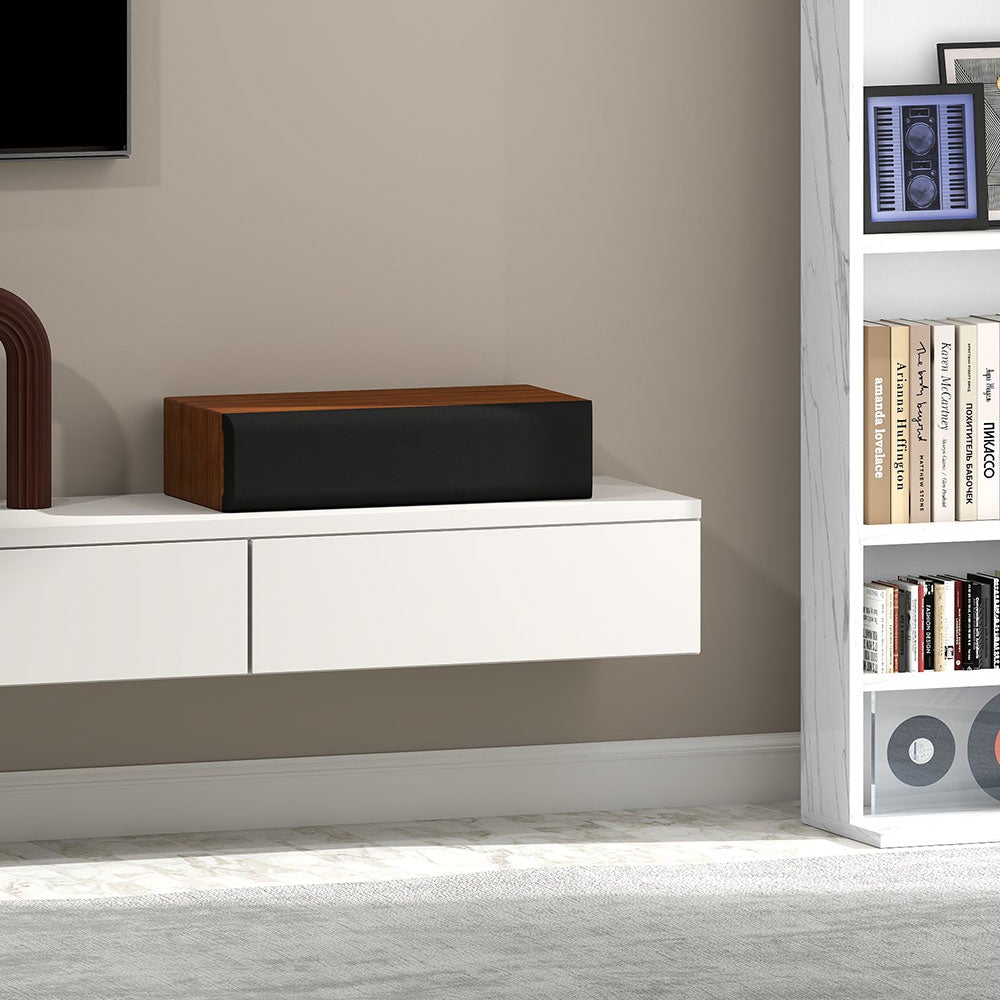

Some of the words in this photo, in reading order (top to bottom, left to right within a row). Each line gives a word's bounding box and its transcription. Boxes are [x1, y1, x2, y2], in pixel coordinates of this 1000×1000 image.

[917, 341, 926, 366] The
[940, 342, 951, 372] Karen
[874, 378, 885, 425] amanda
[896, 362, 907, 413] Arianna
[938, 376, 952, 430] McCartney
[874, 429, 885, 478] lovelace
[894, 419, 907, 490] Huffington
[983, 422, 995, 479] ПИКАССО
